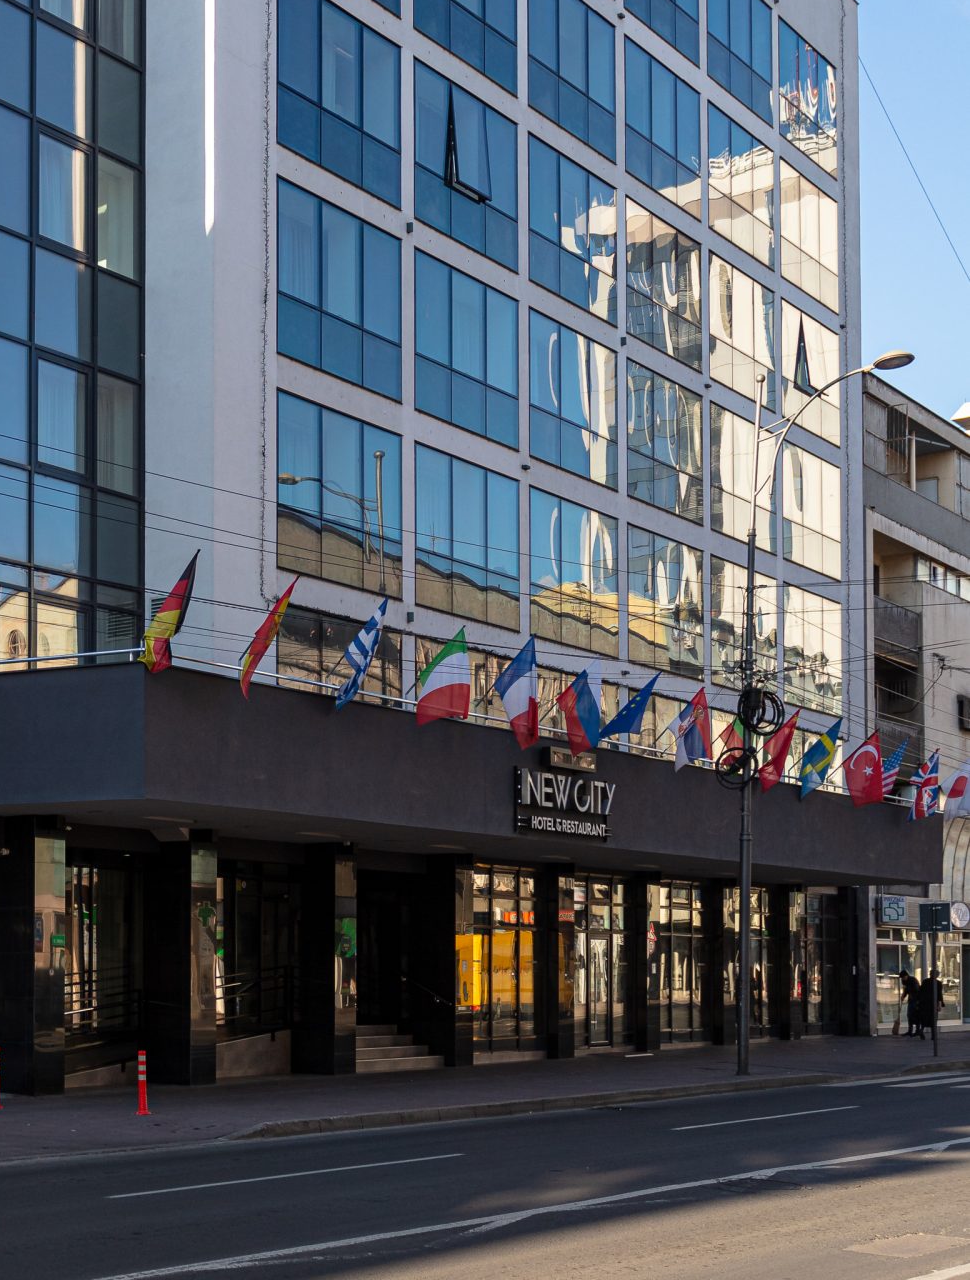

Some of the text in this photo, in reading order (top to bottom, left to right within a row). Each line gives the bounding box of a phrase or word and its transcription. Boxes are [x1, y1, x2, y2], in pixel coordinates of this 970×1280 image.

[522, 768, 616, 815] NEW CITY
[531, 815, 606, 837] HOTEL & RESTAURANT
